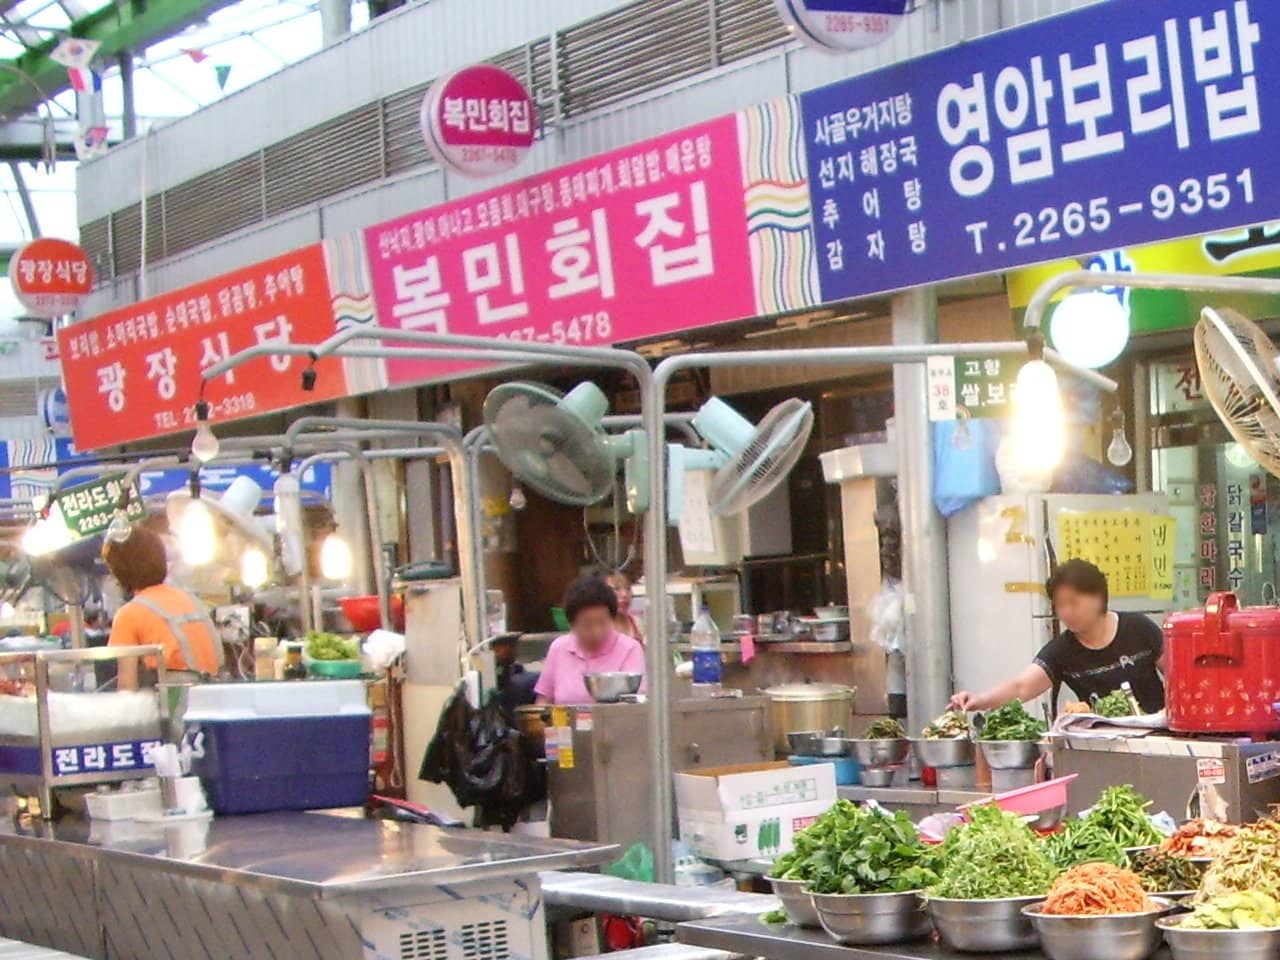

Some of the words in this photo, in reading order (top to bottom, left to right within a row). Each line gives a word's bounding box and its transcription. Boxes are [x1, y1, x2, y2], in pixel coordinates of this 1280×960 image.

[443, 96, 531, 133] 복민회집
[814, 92, 913, 146] 사골우거지탕
[937, 0, 1261, 197] 영암보리밥
[819, 152, 854, 189] 선지
[859, 136, 917, 177] 해장국
[822, 178, 921, 230] 추어탕
[20, 259, 87, 284] 광장식당
[826, 220, 926, 271] 감자탕
[97, 314, 294, 412] 광장식당
